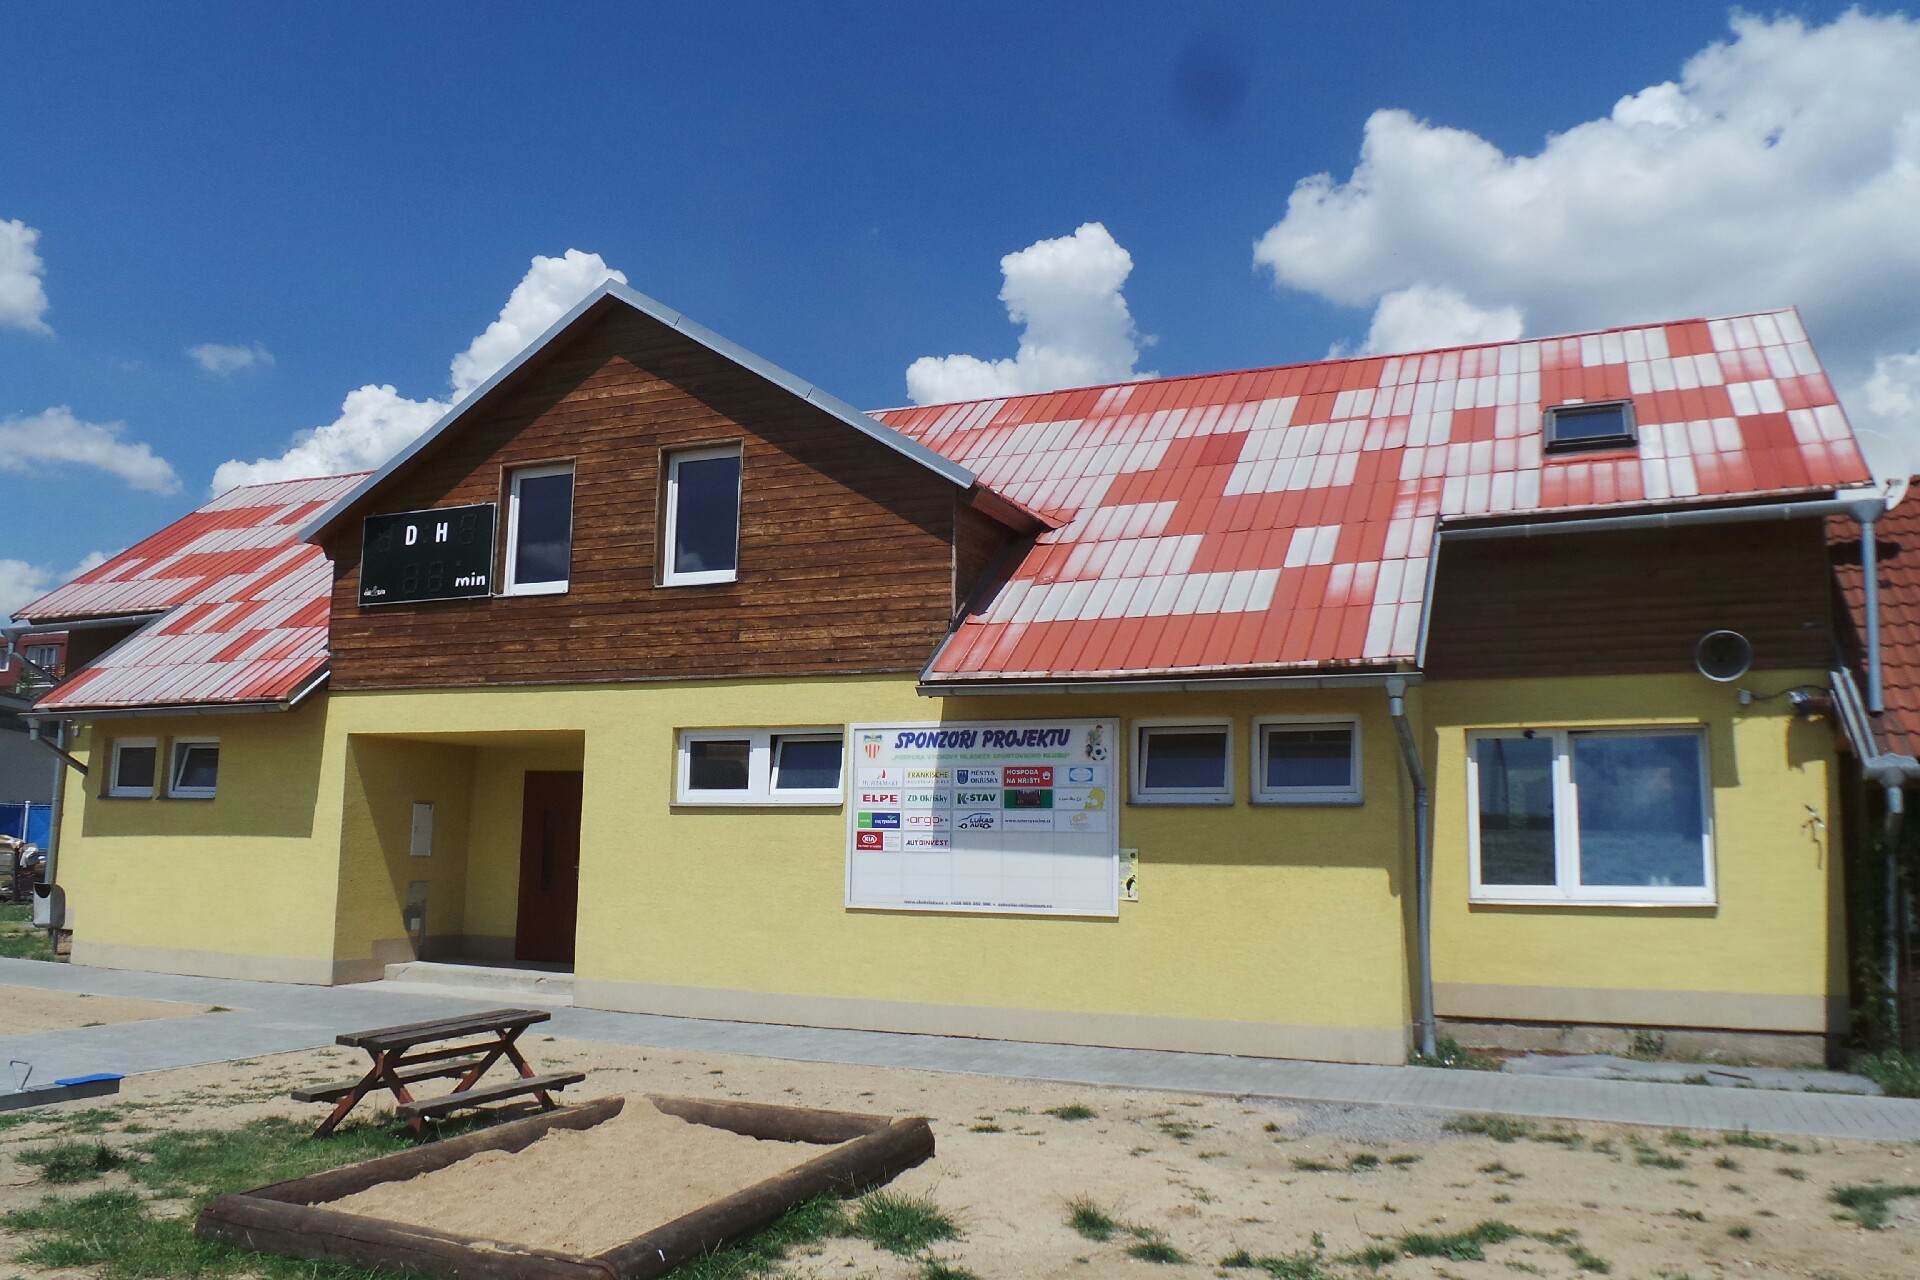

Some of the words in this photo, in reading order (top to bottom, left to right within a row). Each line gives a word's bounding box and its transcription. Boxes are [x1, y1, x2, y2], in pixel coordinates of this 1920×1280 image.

[405, 525, 418, 545] D
[435, 522, 448, 543] H
[455, 572, 486, 587] min
[895, 730, 978, 749] SPONZOŘI
[981, 728, 1070, 748] PROJEKTU
[862, 794, 898, 802] ELPE
[907, 794, 918, 802] ZD
[957, 793, 997, 804] K-STAV
